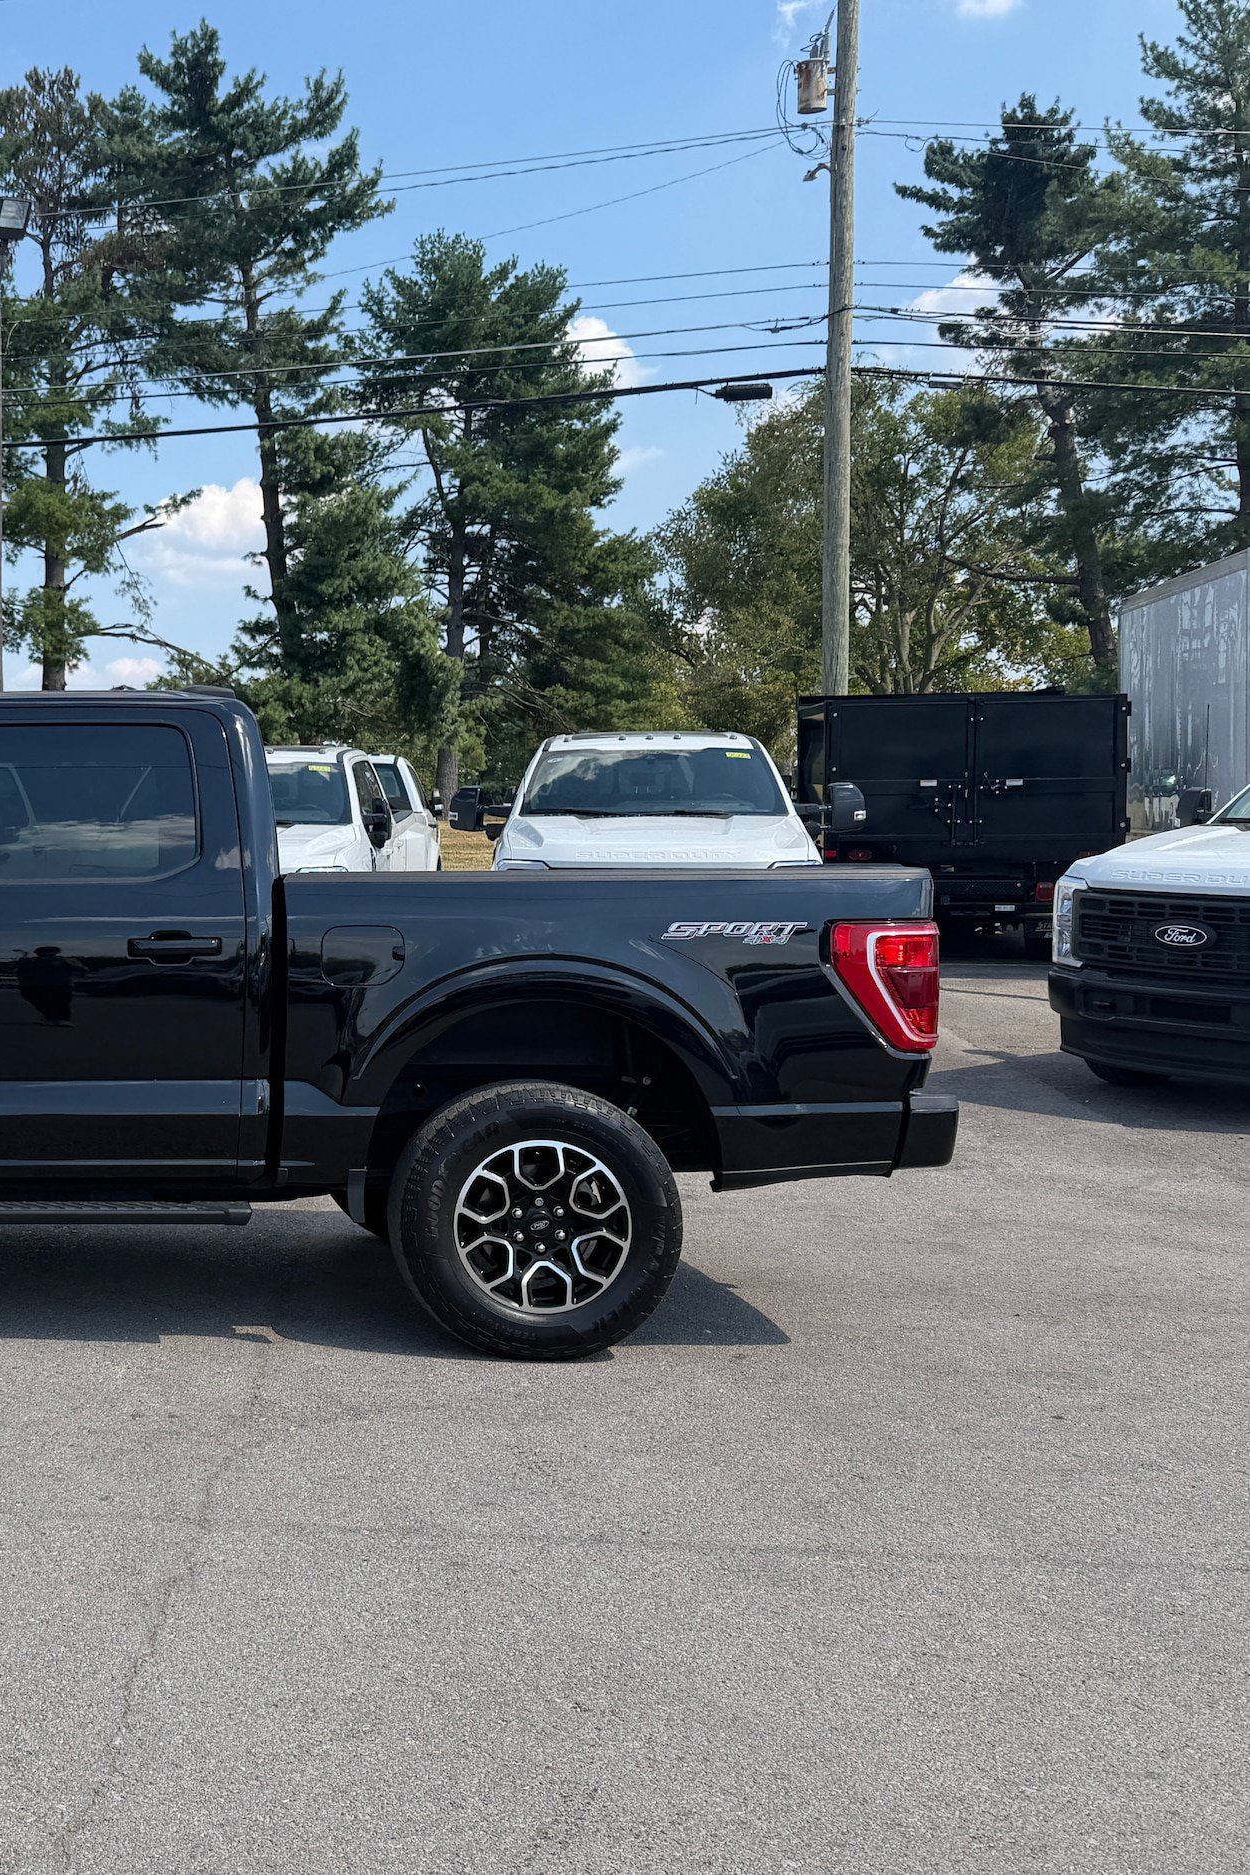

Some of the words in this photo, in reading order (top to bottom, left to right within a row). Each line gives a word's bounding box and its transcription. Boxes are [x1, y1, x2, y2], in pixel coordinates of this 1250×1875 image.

[575, 851, 667, 860] SUPER
[670, 851, 741, 860] DUTY
[1110, 869, 1201, 883] SUPER
[661, 922, 808, 940] SPORT
[1163, 927, 1197, 944] Ford
